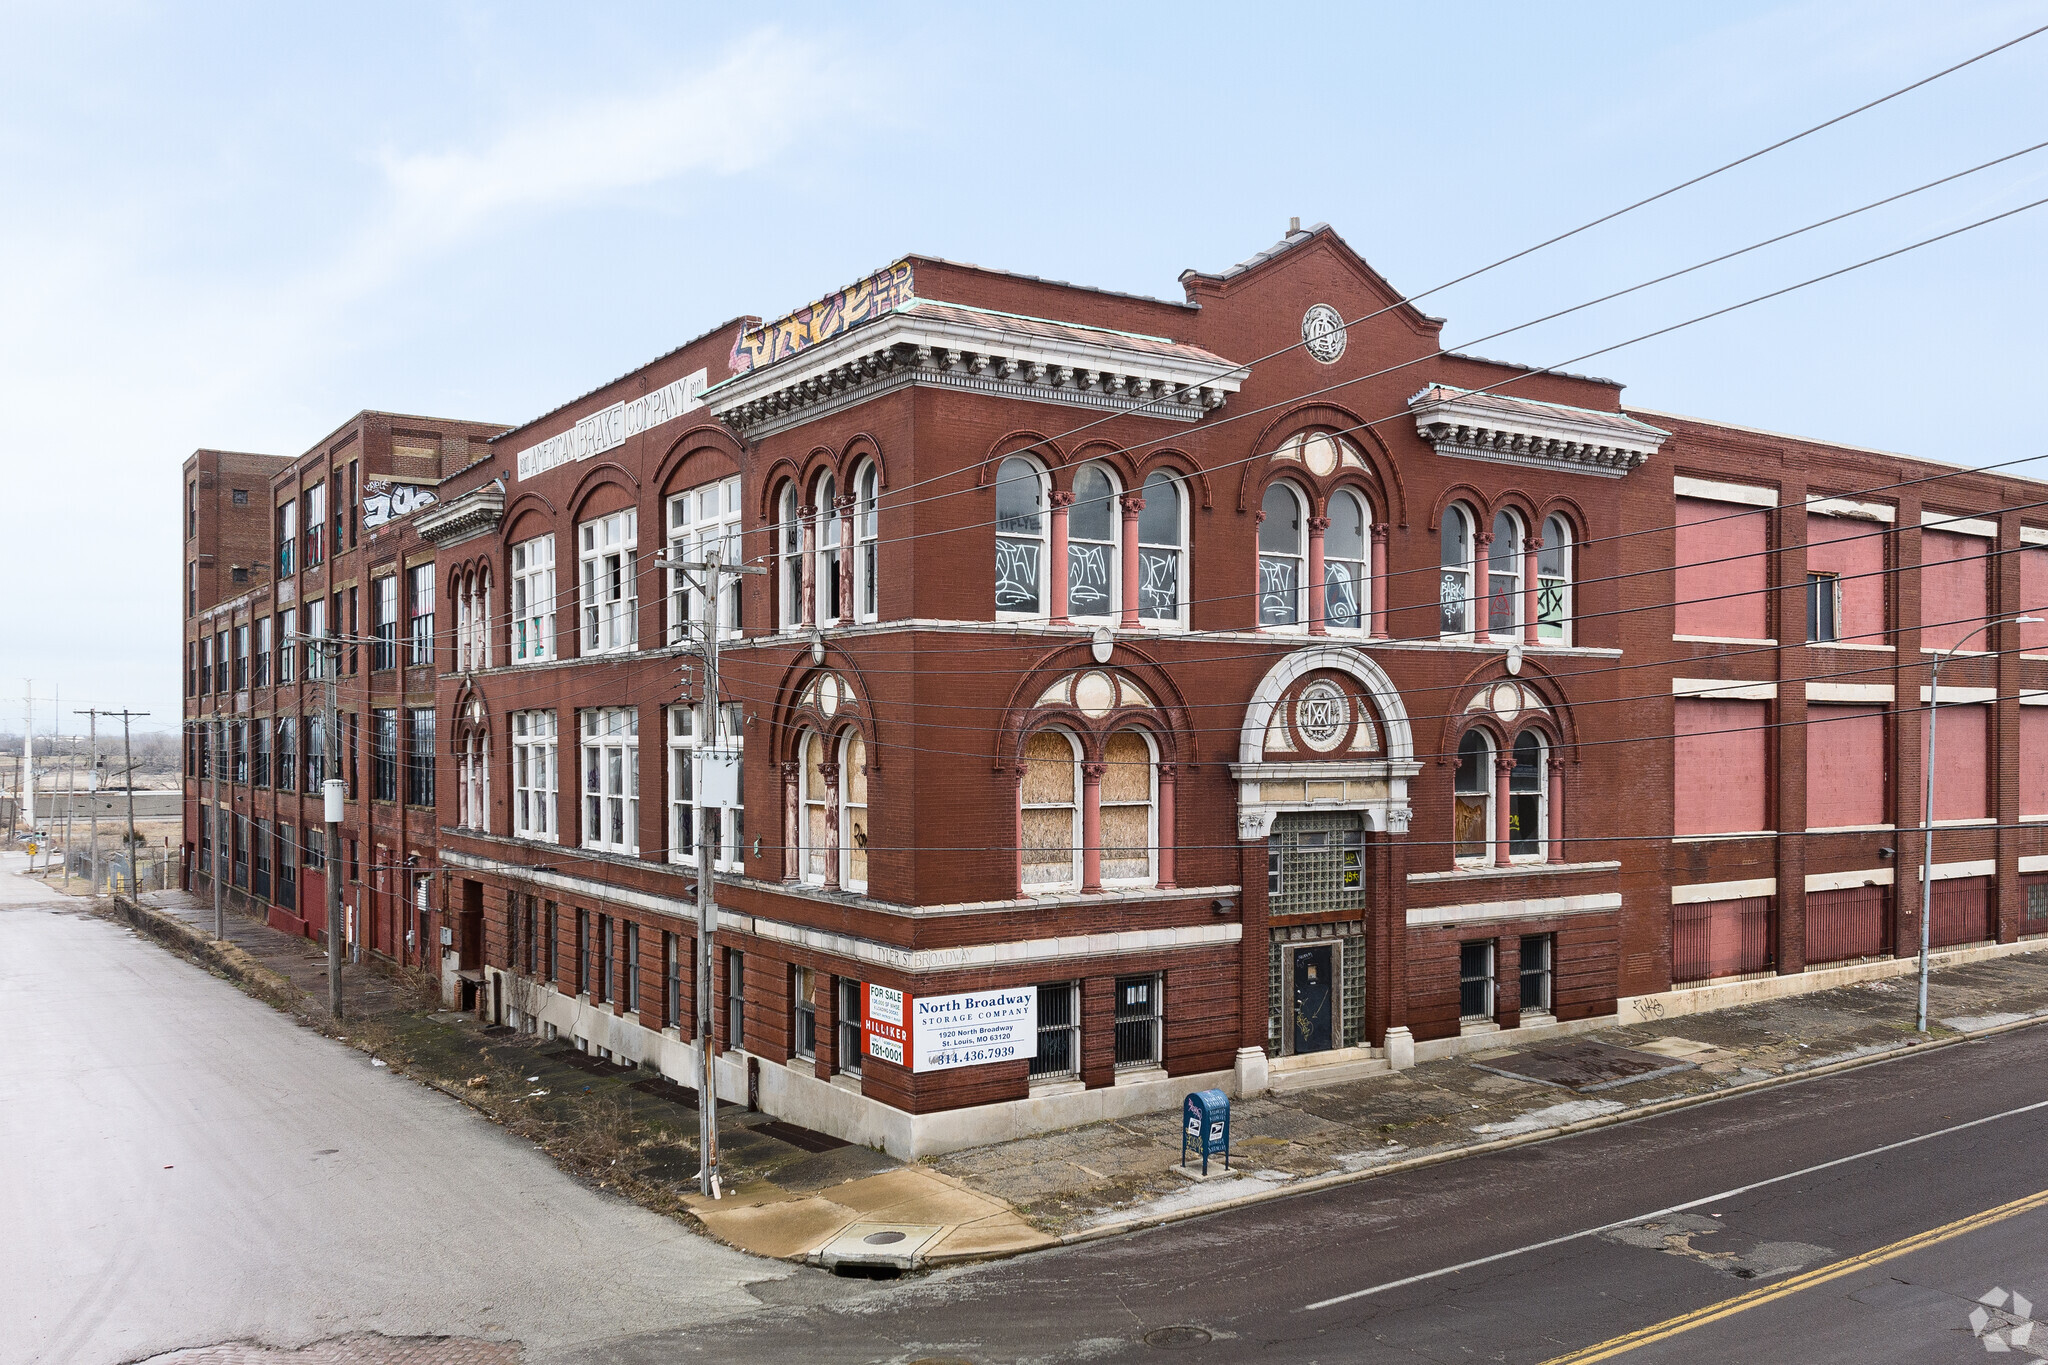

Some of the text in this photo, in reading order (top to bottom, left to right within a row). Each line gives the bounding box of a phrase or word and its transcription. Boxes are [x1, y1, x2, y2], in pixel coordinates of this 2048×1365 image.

[530, 429, 576, 476] AMERICAN
[579, 406, 623, 458] BRAKE
[627, 378, 687, 435] COMPANY
[877, 946, 900, 965] TYLER
[914, 949, 974, 968] BROADWAY
[870, 986, 902, 1003] FOR SALE
[919, 999, 961, 1014] North
[965, 994, 1032, 1010] Broadway
[922, 1007, 1029, 1026] STORAGE COMPANY
[865, 1019, 907, 1041] HILLIKER
[939, 1025, 1014, 1039] 1920 North Broadway
[953, 1038, 975, 1046] Louis,
[976, 1035, 988, 1043] MO
[989, 1032, 1011, 1041] 63120
[937, 1045, 1015, 1066] 314.436.7939
